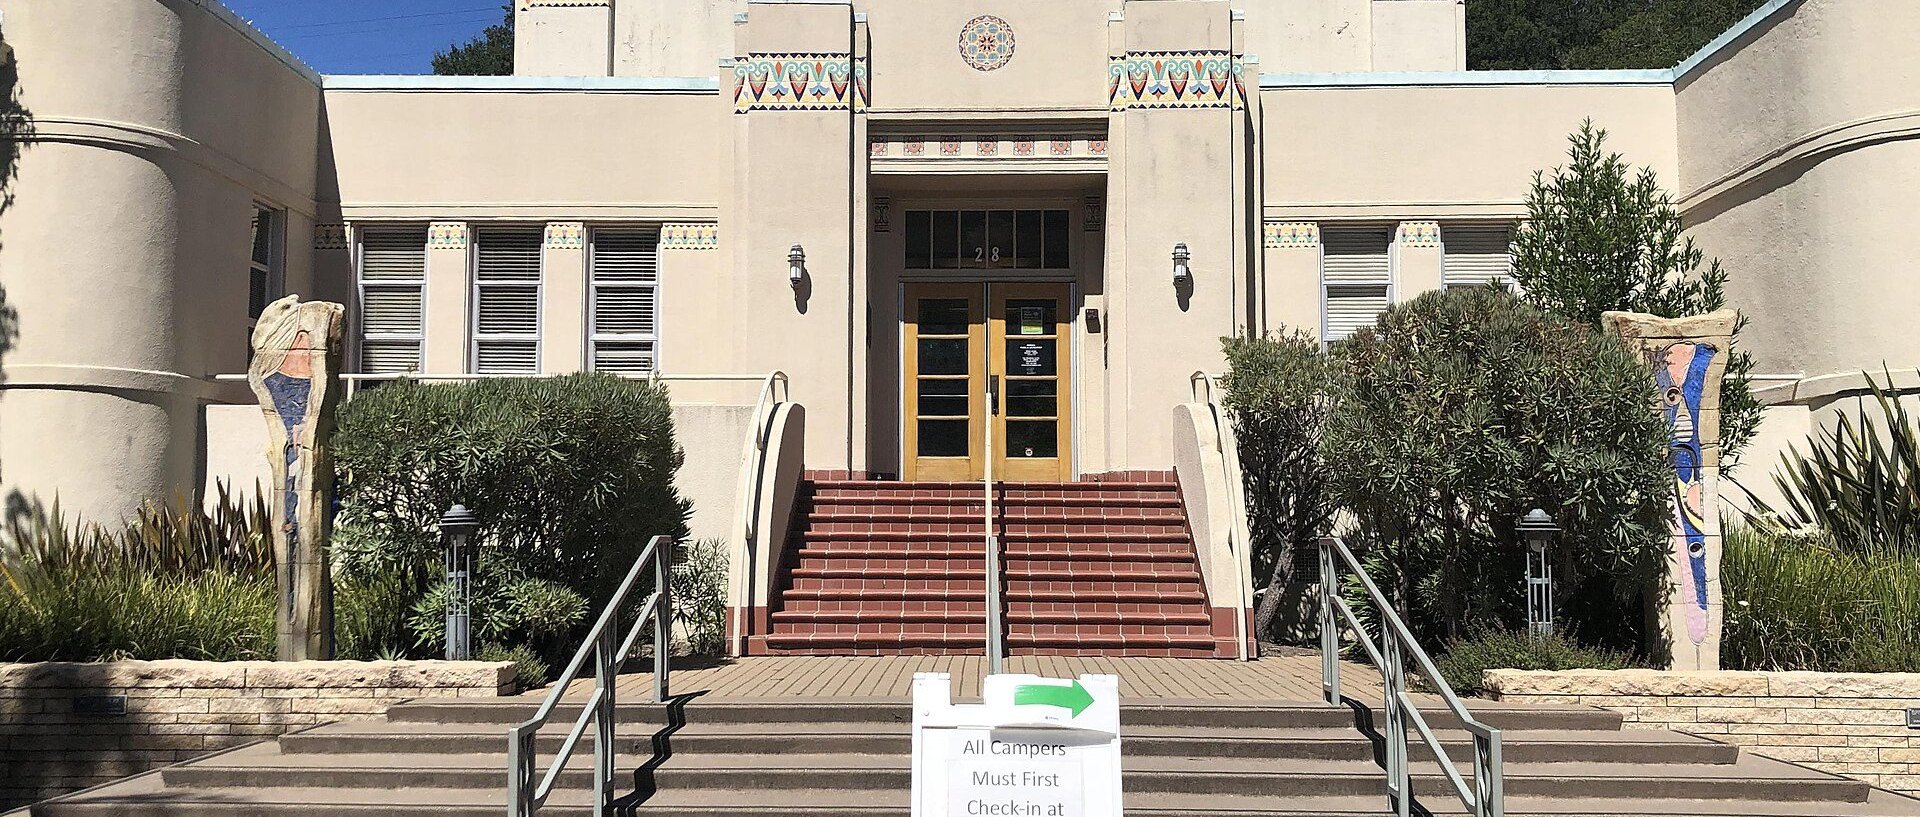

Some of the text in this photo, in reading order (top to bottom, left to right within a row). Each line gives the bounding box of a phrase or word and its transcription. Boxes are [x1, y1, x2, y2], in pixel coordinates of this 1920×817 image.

[975, 246, 1000, 262] 28
[963, 740, 1066, 759] All Campers
[972, 771, 1060, 788] Must First
[967, 799, 1064, 817] Check-in at
